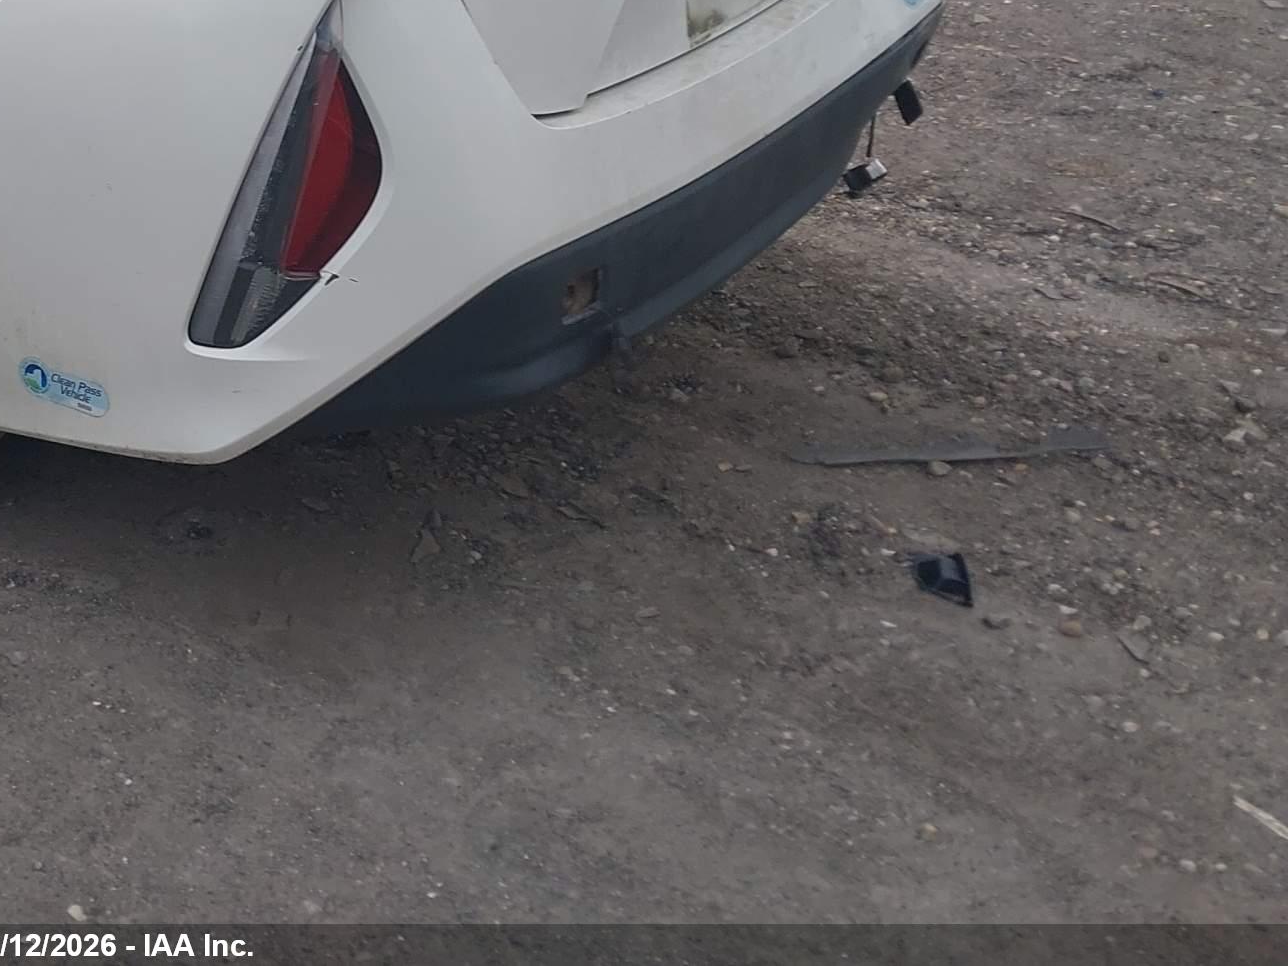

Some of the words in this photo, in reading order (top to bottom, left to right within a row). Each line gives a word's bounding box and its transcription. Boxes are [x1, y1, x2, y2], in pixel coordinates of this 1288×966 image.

[51, 373, 76, 389] Clean
[78, 382, 102, 397] Pass
[60, 385, 92, 403] Vehicle
